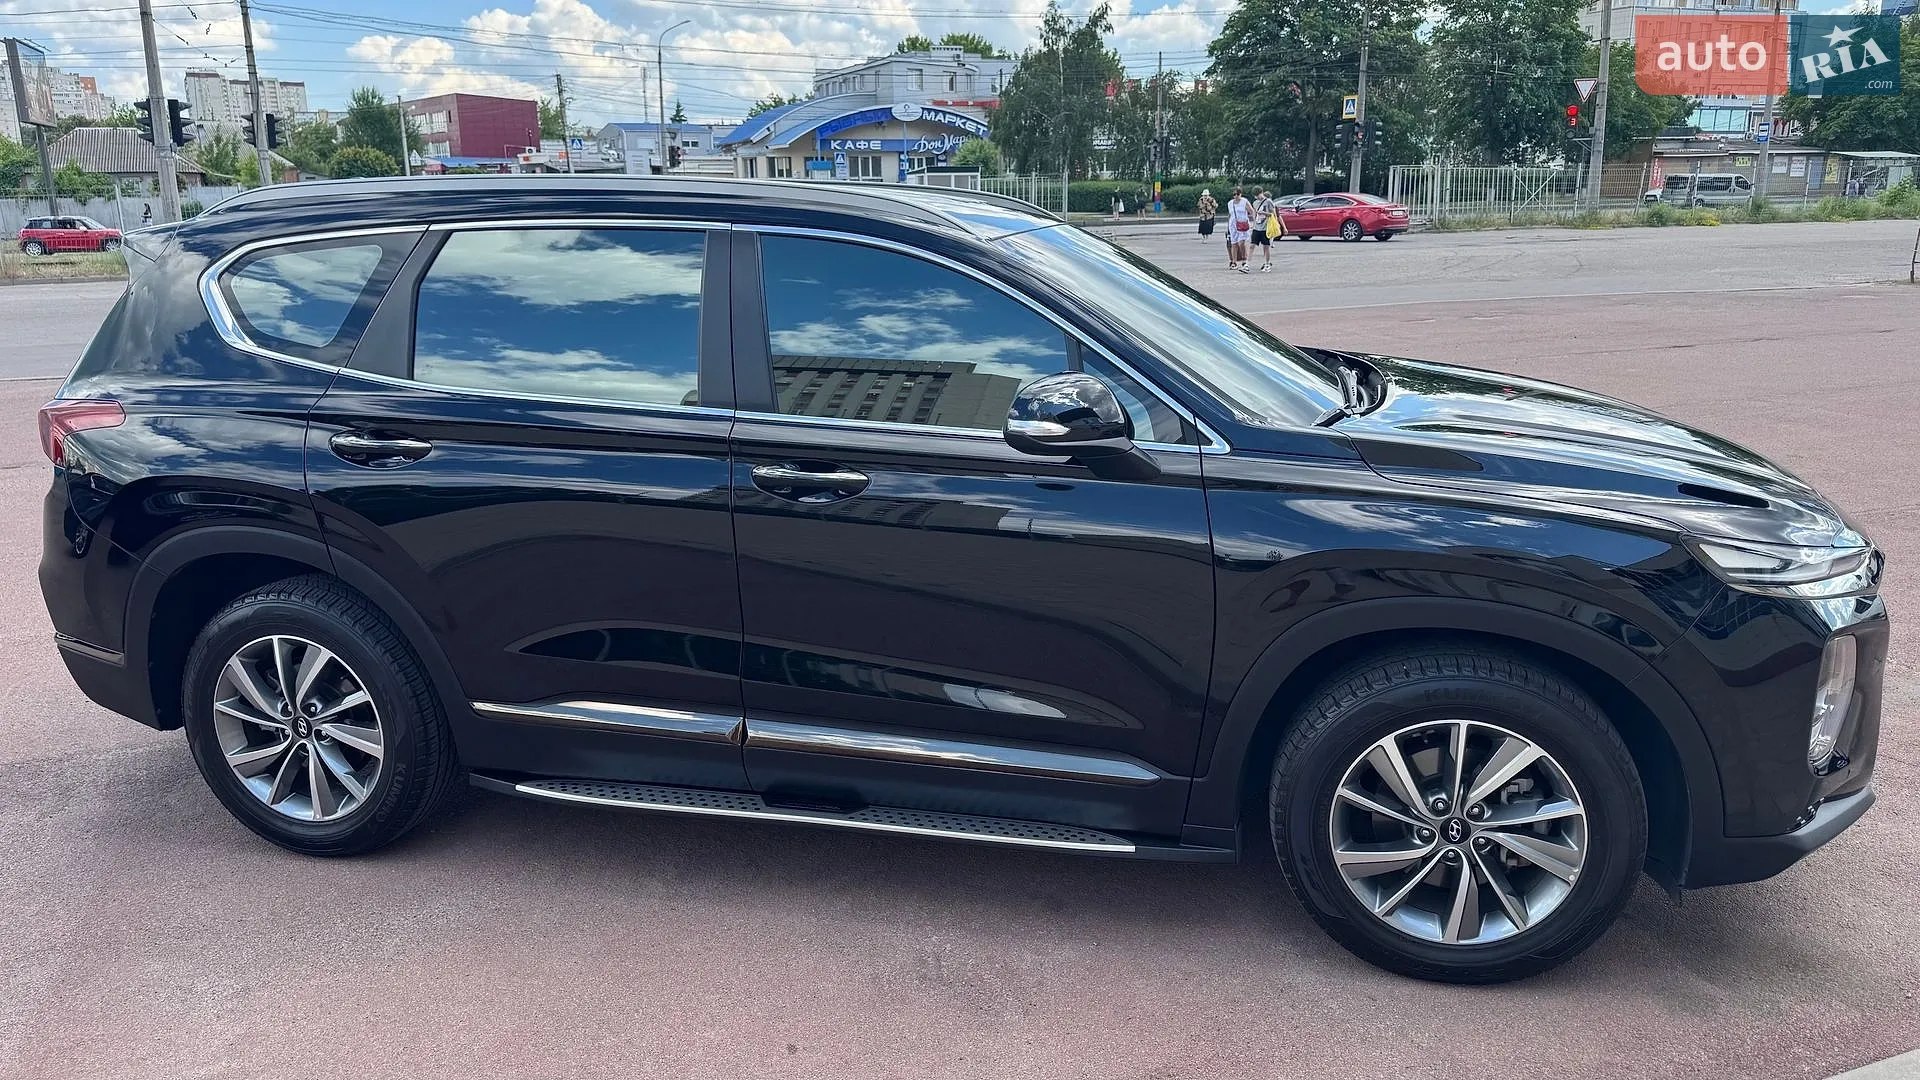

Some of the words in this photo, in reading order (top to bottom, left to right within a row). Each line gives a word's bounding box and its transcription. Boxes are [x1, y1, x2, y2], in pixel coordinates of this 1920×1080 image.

[922, 110, 988, 135] МАРКЕТ
[831, 139, 882, 150] КАФЕ
[912, 134, 944, 153] Дон
